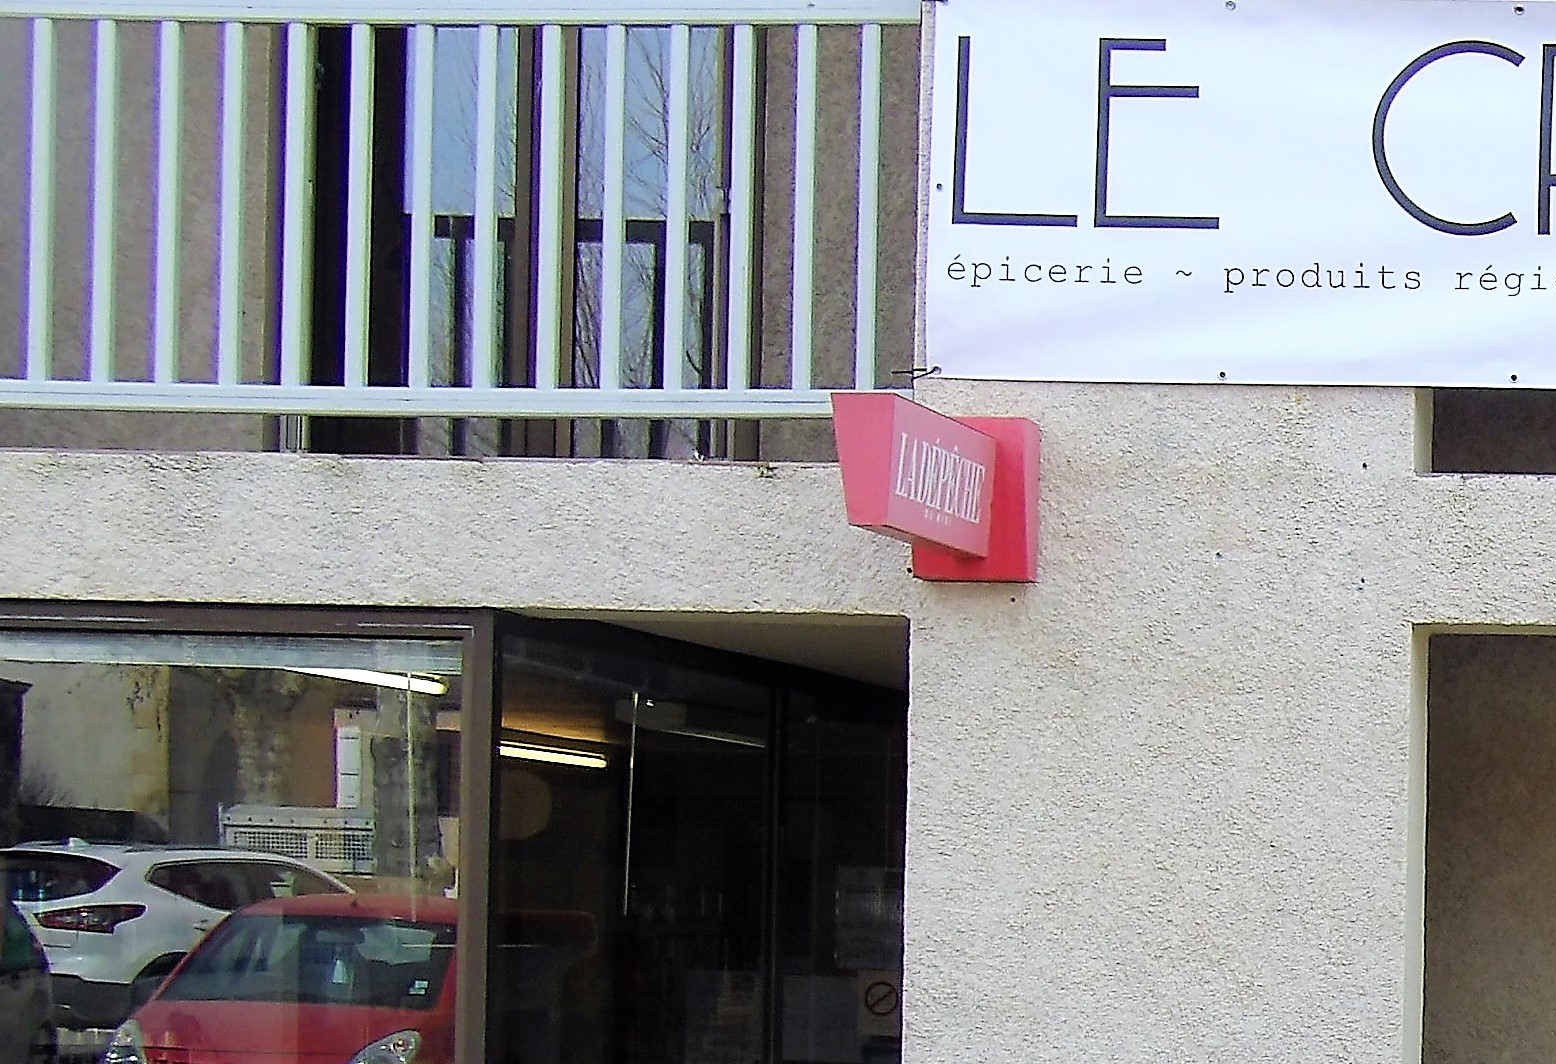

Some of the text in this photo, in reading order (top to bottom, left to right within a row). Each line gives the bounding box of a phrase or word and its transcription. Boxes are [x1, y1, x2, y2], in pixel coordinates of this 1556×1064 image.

[951, 35, 1220, 229] LE
[947, 254, 1144, 287] épicerie
[1222, 262, 1422, 294] produits
